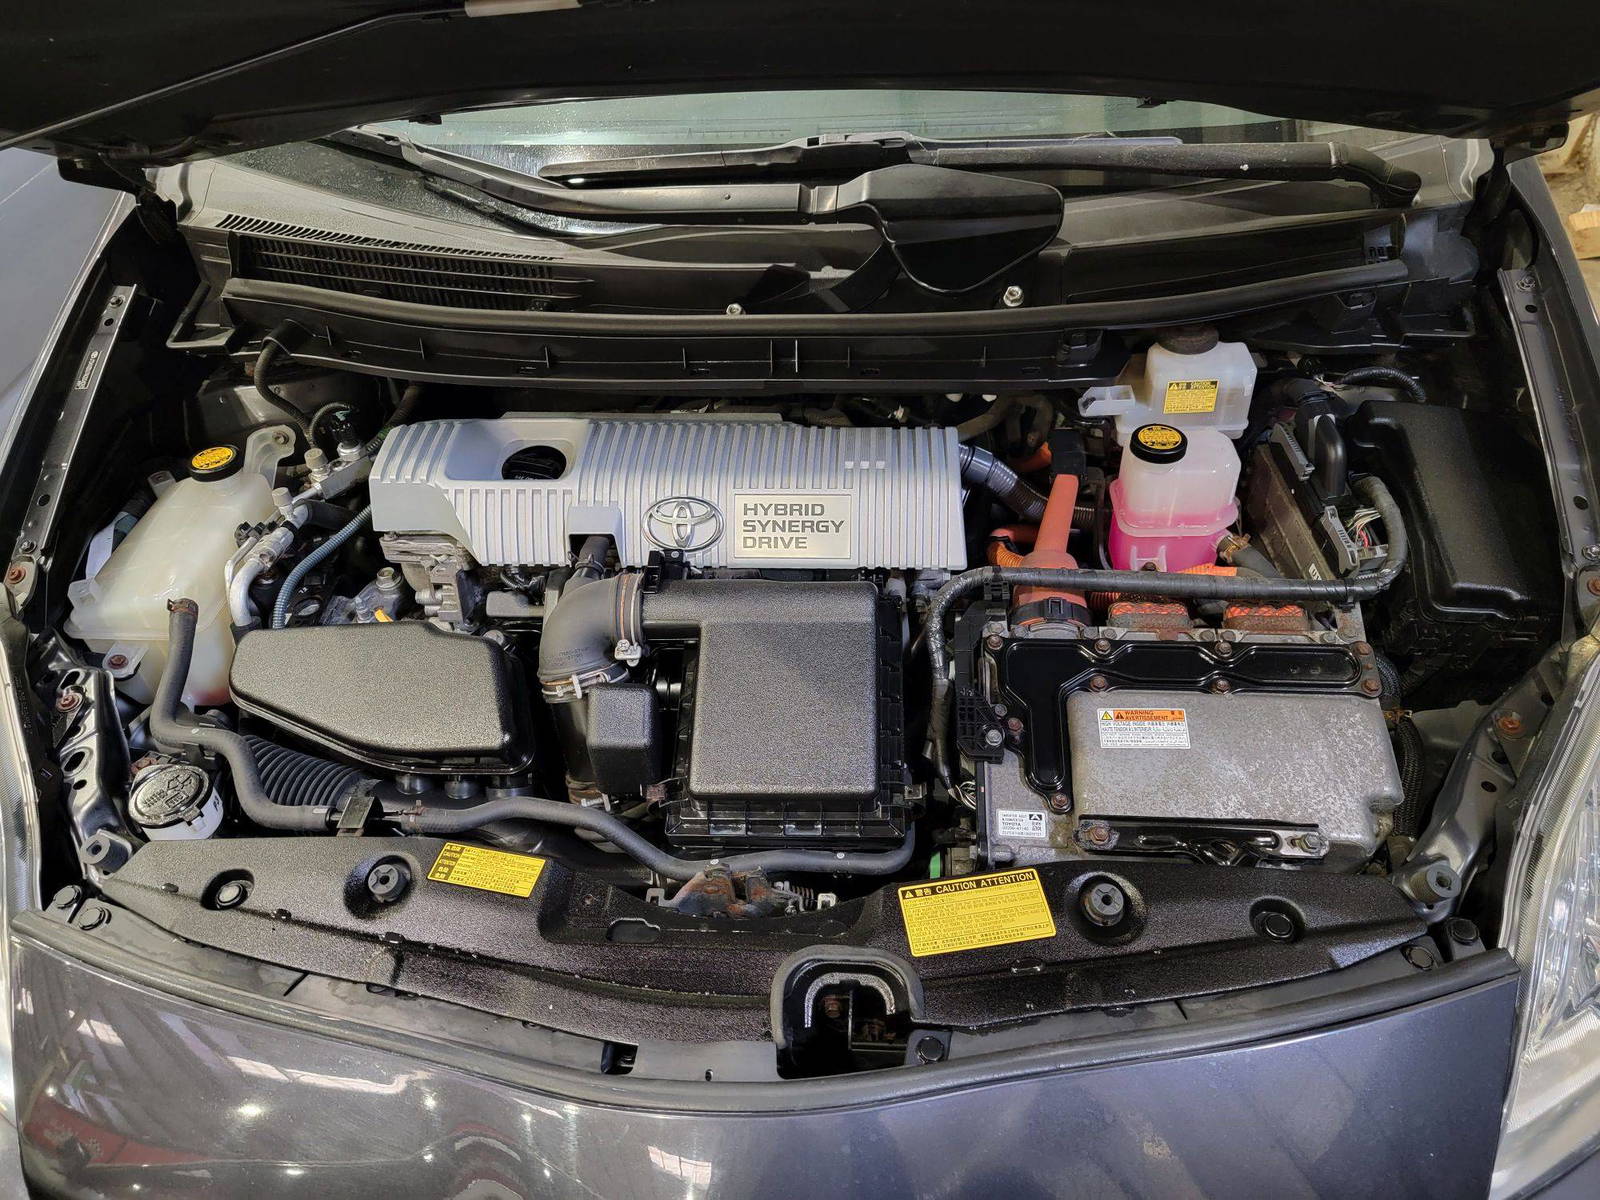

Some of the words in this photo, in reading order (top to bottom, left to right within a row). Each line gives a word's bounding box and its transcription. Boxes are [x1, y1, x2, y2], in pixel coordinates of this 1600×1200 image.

[743, 503, 825, 516] HYBRID
[742, 519, 845, 533] SYNERGY
[742, 536, 808, 549] DRIVE
[935, 880, 977, 894] CAUTION
[980, 872, 1033, 887] ATTENTION
